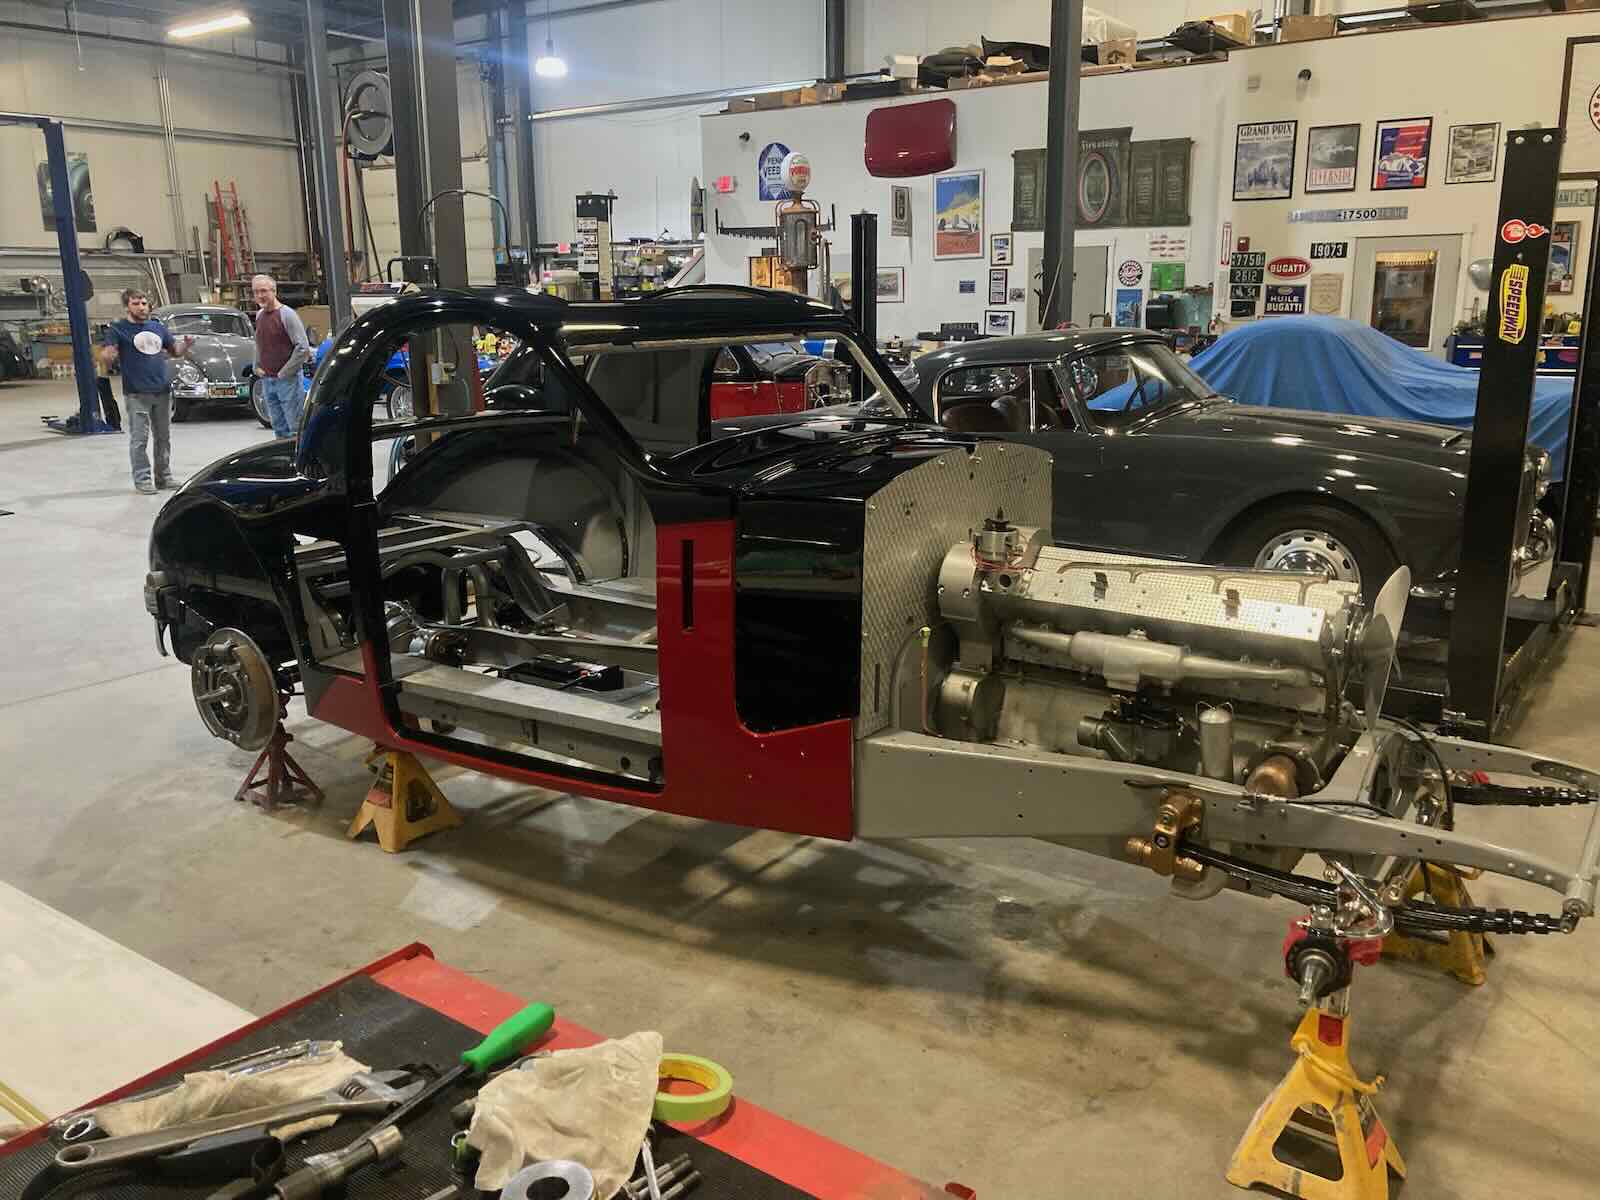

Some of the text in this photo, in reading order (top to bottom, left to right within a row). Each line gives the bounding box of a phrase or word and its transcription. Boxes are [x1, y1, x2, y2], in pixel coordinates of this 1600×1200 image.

[1240, 123, 1293, 138] GRAND PRIX
[1313, 244, 1343, 257] 19073
[1270, 263, 1306, 273] BUGATTI
[1270, 295, 1299, 303] HUILE
[1266, 303, 1302, 312] BUGATTI
[1503, 279, 1523, 340] SPEEDWAY
